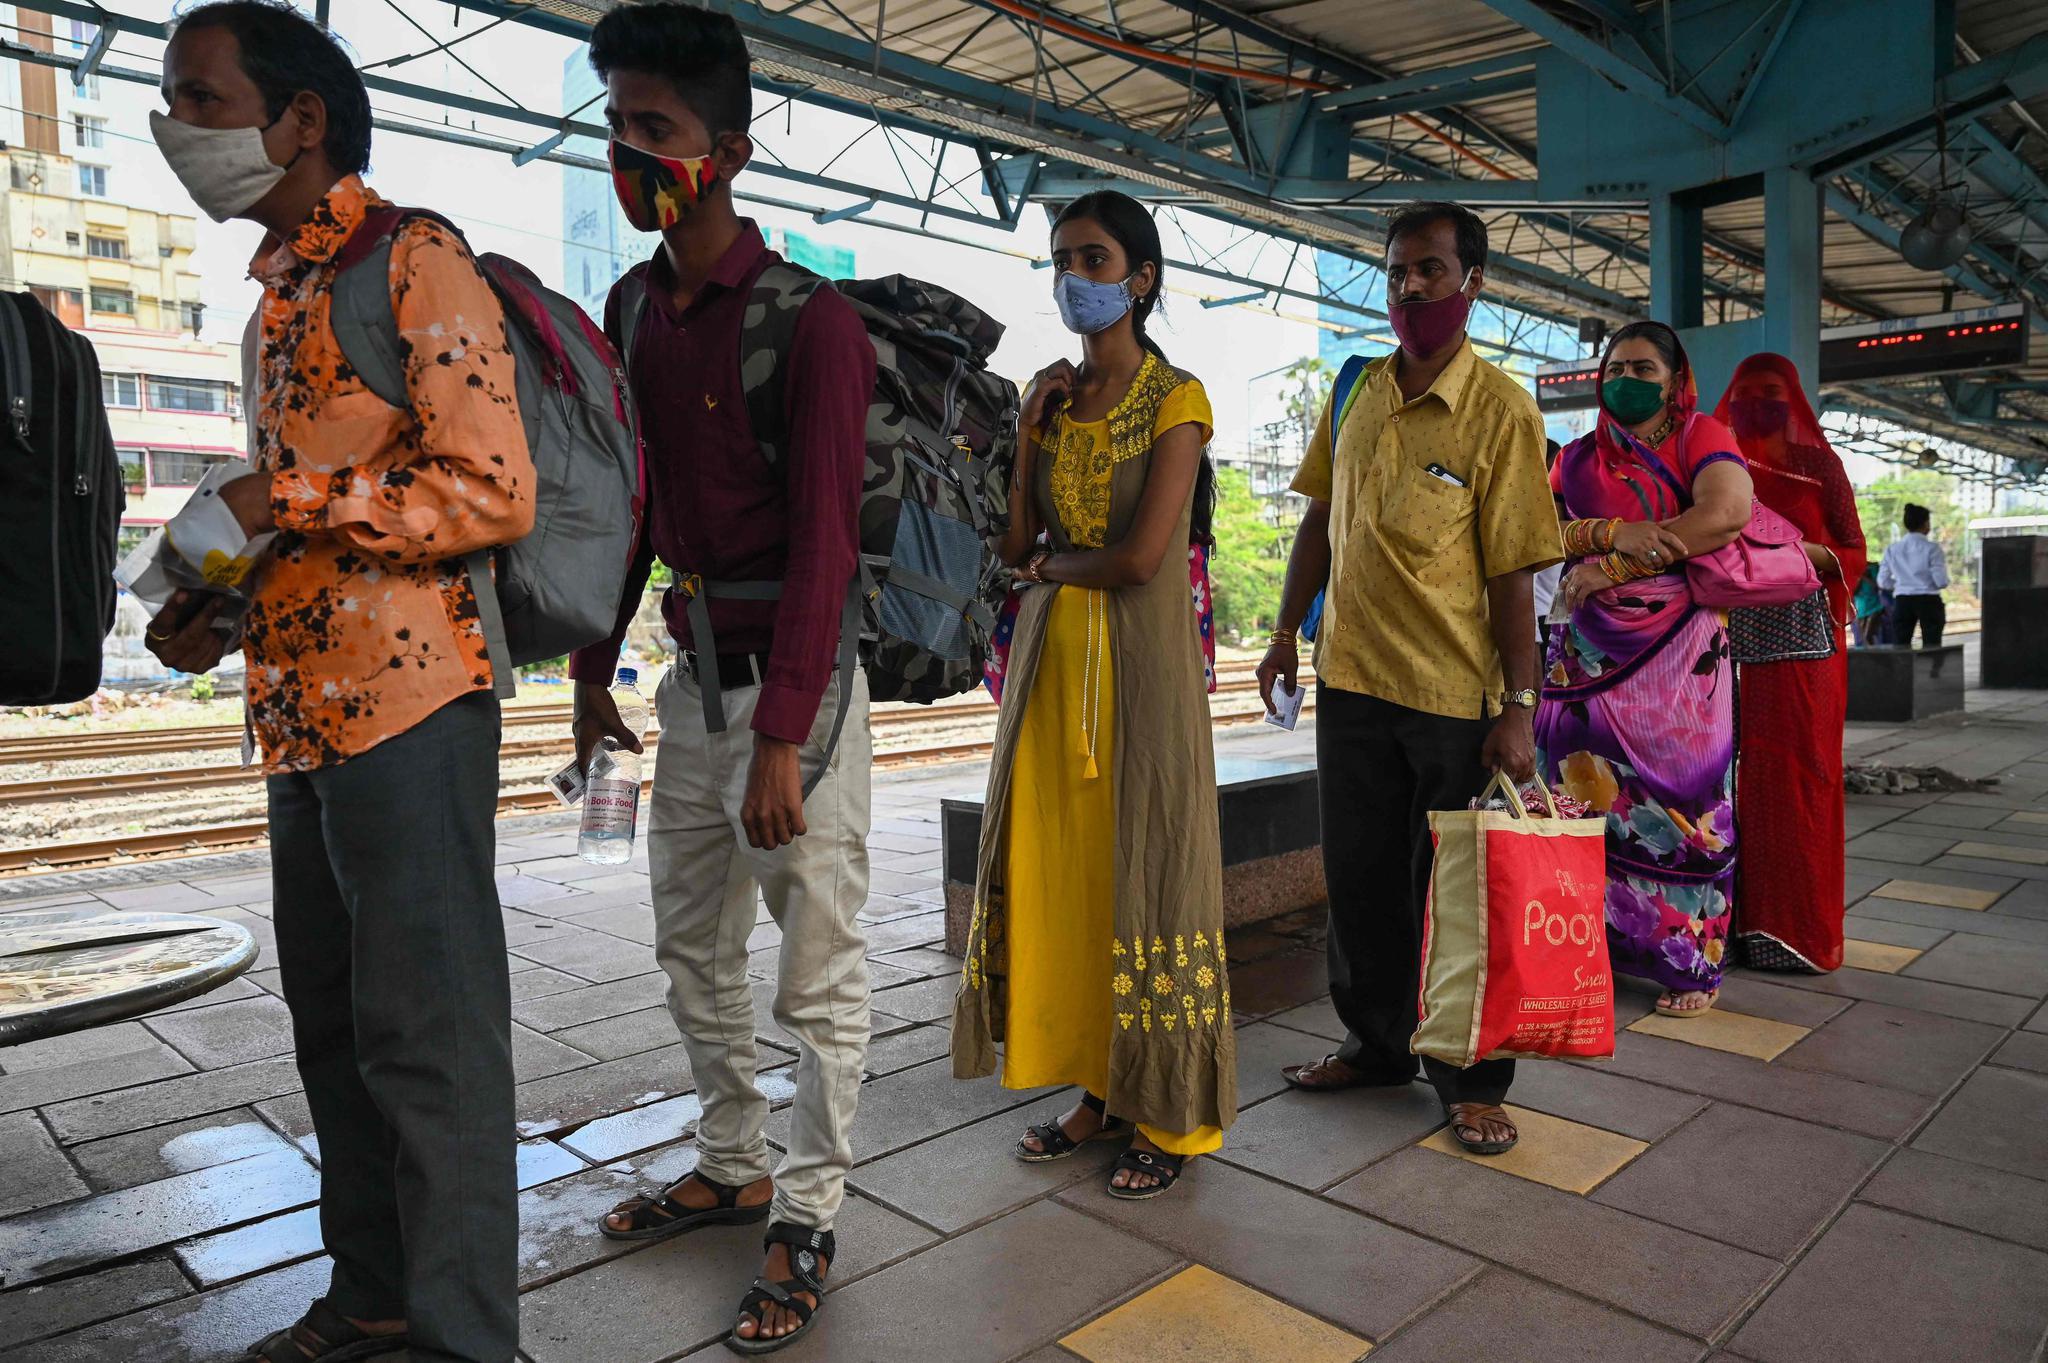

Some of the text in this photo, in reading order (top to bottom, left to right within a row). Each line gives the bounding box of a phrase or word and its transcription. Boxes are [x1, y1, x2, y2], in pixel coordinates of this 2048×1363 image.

[591, 796, 612, 805] Book
[615, 797, 633, 808] Food
[1523, 999, 1571, 1011] WHOLESALE
